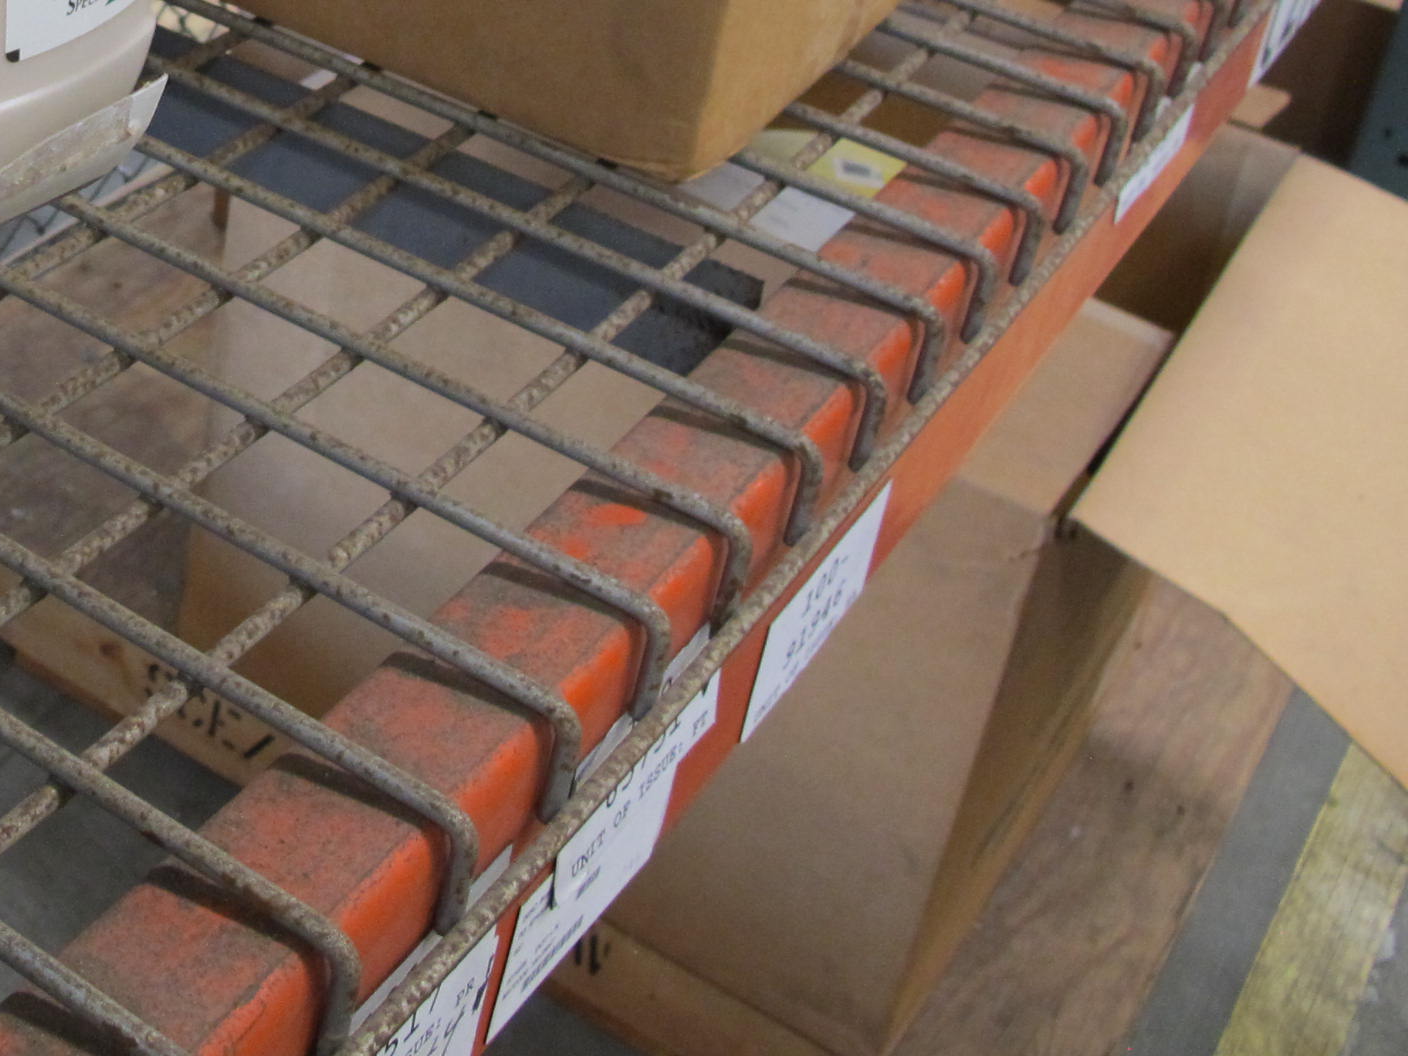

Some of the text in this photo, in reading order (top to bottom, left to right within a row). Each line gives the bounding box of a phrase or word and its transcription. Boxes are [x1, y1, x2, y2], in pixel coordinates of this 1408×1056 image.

[570, 833, 606, 878] UNIT
[613, 803, 631, 829] OF
[637, 740, 684, 804] ISSUE:
